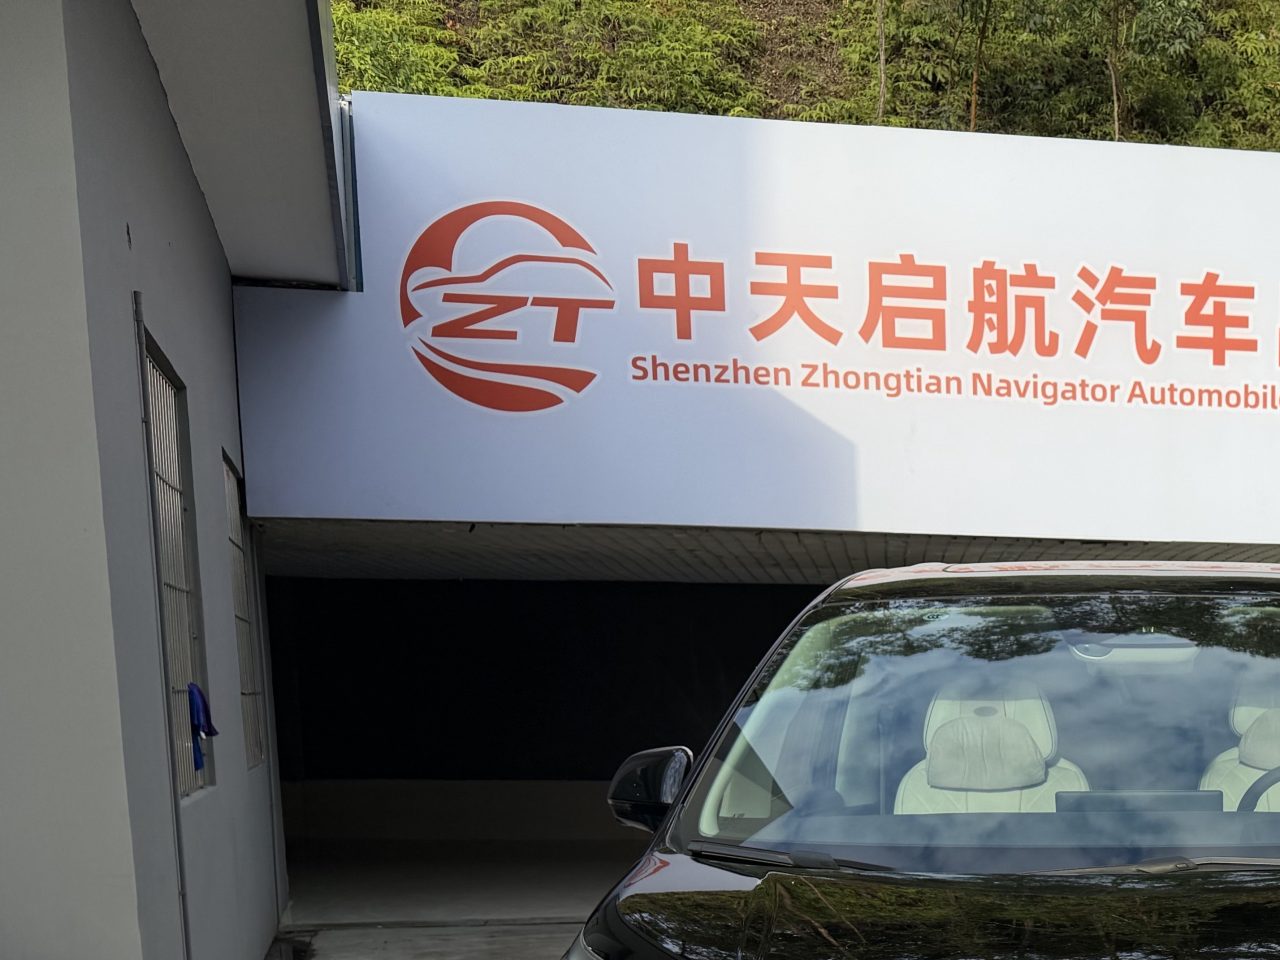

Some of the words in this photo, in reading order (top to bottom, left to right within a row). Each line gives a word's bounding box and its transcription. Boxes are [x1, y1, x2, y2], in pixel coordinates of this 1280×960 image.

[632, 355, 792, 386] Shenzhen
[801, 362, 962, 398] Zhongtian
[971, 372, 1120, 406] Navigator
